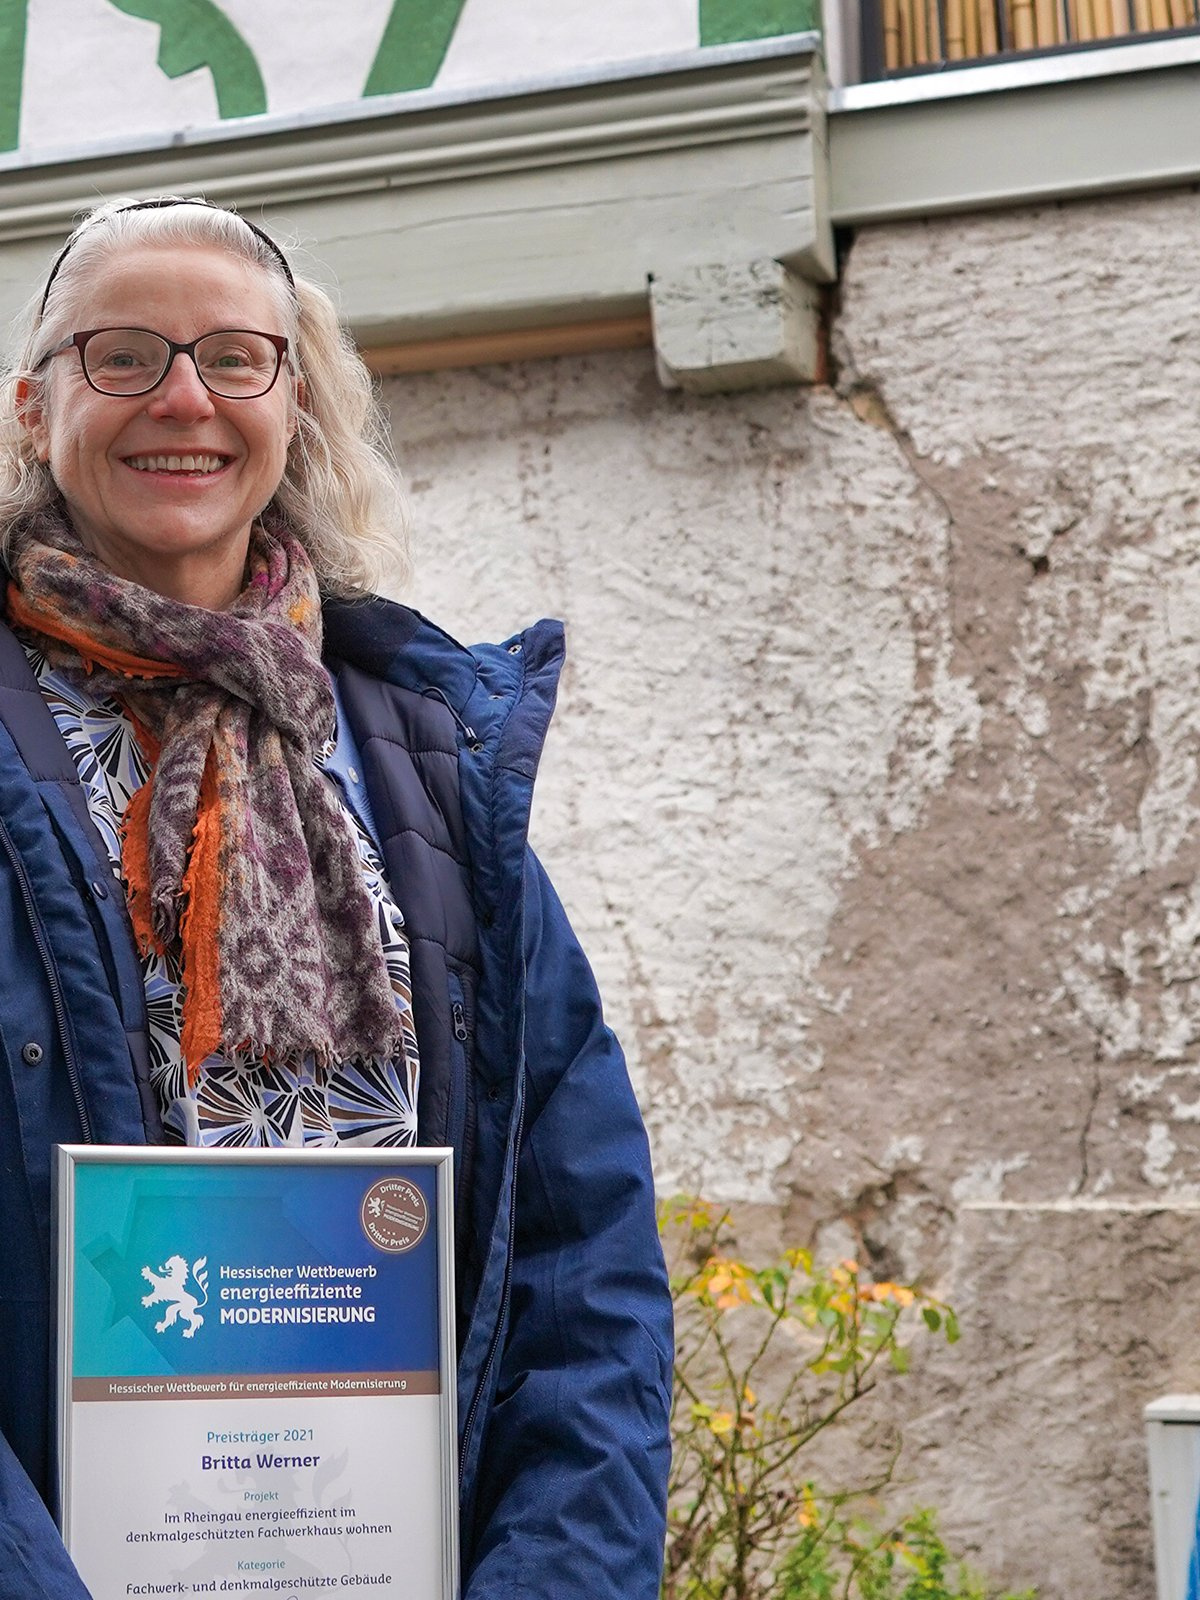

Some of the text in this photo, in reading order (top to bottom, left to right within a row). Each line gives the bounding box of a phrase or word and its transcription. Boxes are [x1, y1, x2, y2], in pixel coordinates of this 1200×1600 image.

[380, 1183, 420, 1208] Dritter Preis
[368, 1222, 389, 1245] Dritter
[390, 1236, 410, 1246] Preis
[221, 1265, 376, 1278] Hessischer Wettbewerb
[221, 1284, 361, 1302] energieeffiziente
[221, 1307, 374, 1324] MODERNISIERUNG
[110, 1379, 406, 1394] Hessischer Wettbewerb für energieeffiziente Modernisierung
[208, 1429, 314, 1444] Preisträger 2021
[202, 1454, 320, 1470] Britta Werner
[244, 1491, 279, 1503] Projekt
[165, 1509, 355, 1524] Im Rheingau energieeffizient im
[126, 1524, 391, 1543] denkmalgeschützten Fachwerkhaus wohnen
[238, 1560, 286, 1572] Kategorie
[127, 1574, 391, 1594] Fachwerk- und denkmalgeschützte Gebäude
